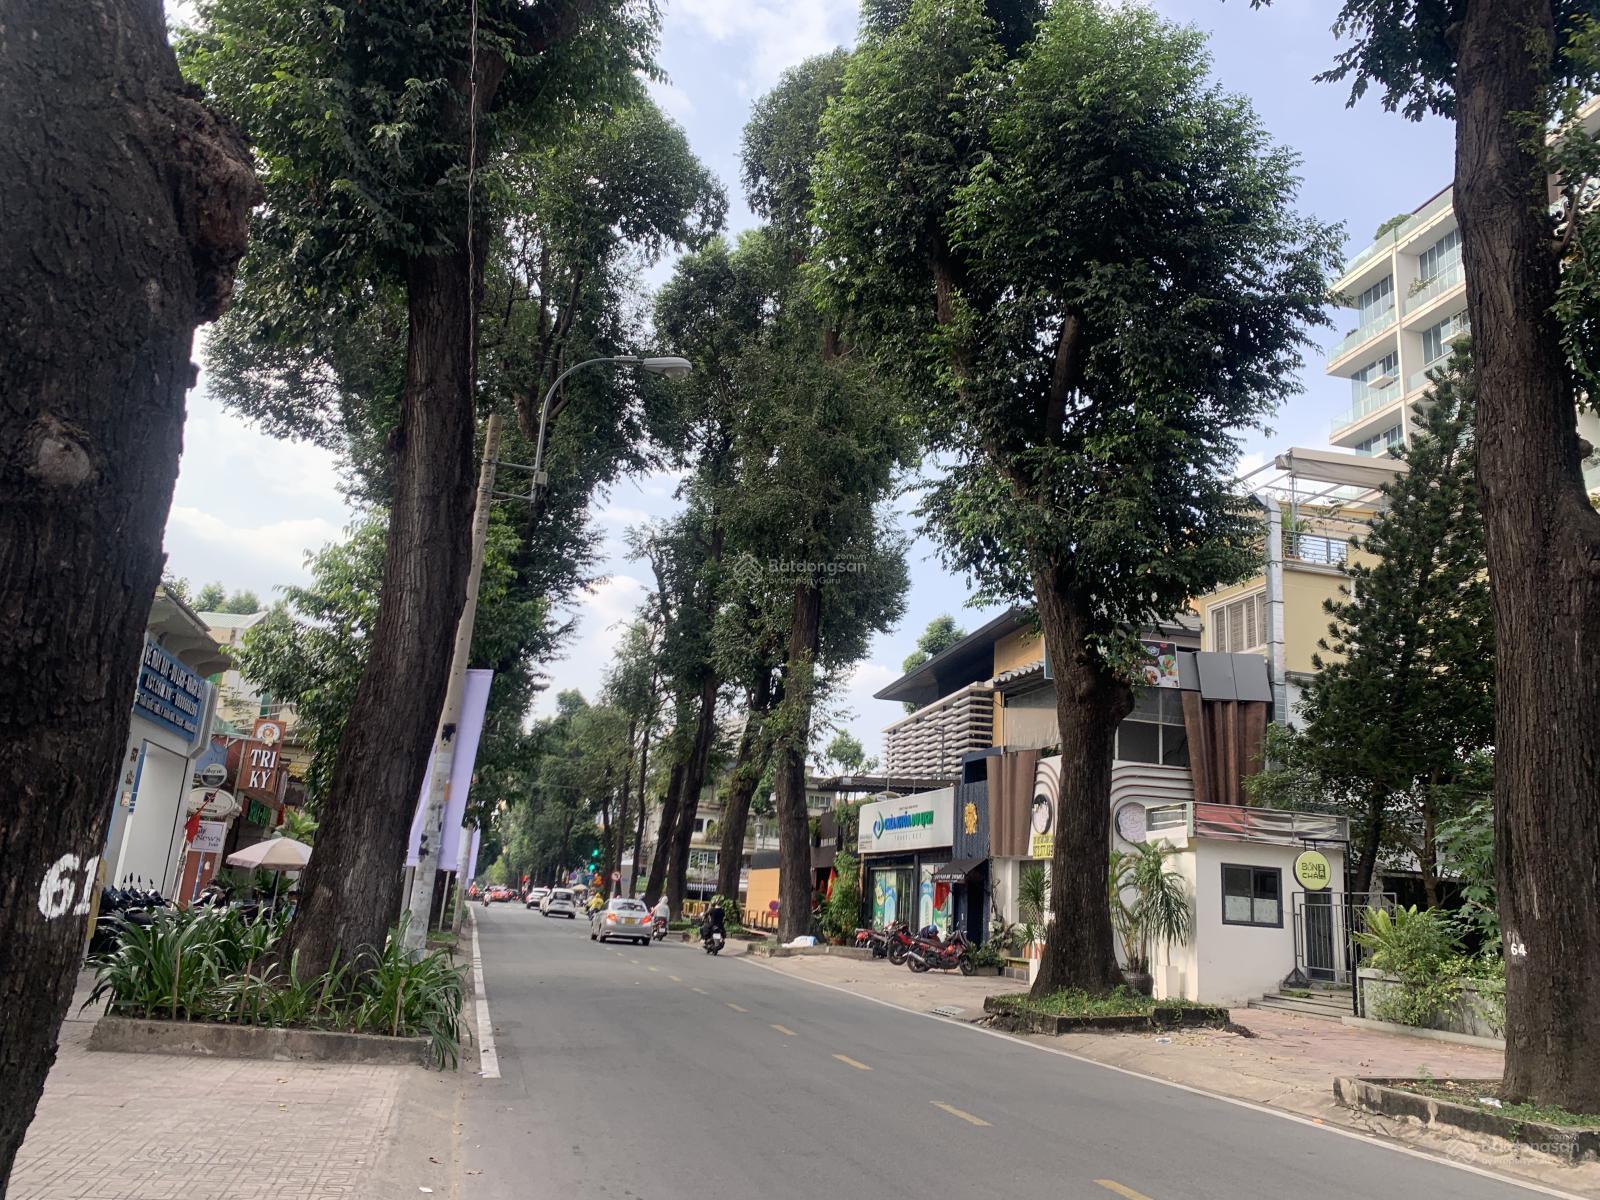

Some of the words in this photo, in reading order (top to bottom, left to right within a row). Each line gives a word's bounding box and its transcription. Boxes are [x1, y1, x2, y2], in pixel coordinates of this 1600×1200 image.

[250, 749, 277, 768] TRI
[38, 853, 100, 921] 61
[1510, 943, 1528, 957] 64
